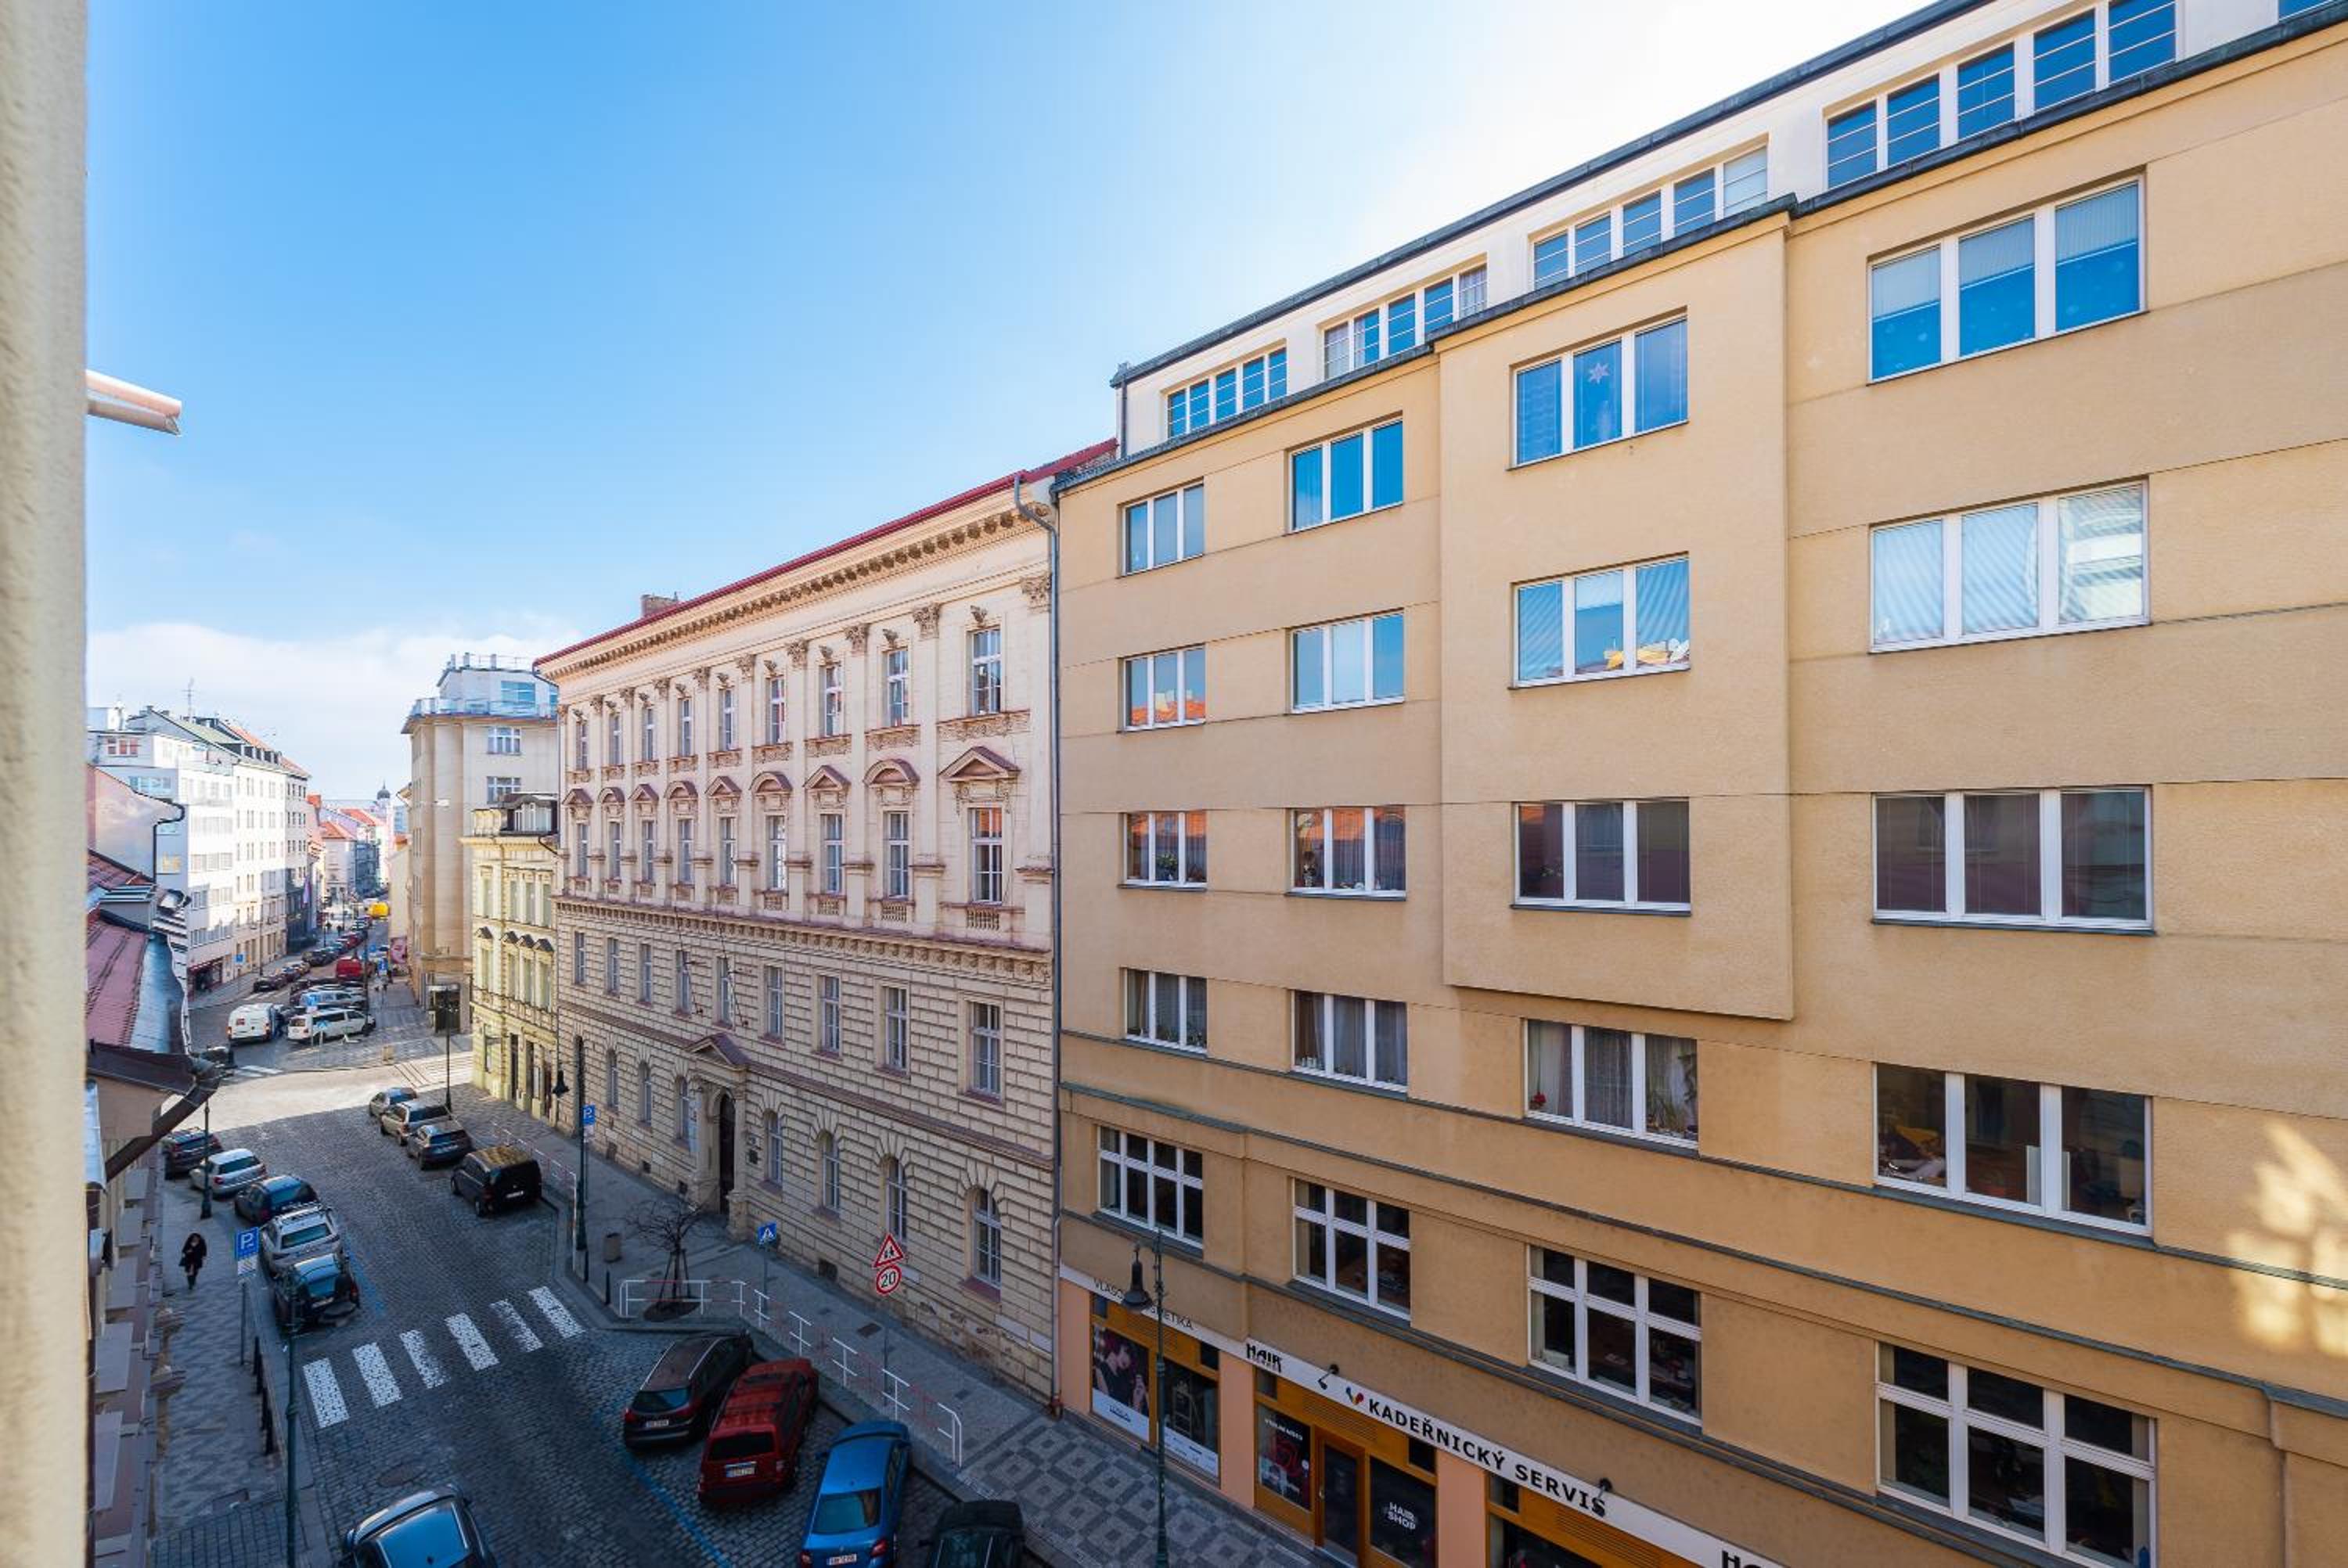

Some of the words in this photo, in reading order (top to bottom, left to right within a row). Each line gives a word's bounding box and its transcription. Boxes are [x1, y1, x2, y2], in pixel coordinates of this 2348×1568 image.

[240, 1232, 254, 1250] P
[880, 1271, 897, 1288] 20
[1246, 1343, 1282, 1373] HAIR
[1369, 1398, 1505, 1471] KADEŘNICKÝ
[1515, 1463, 1607, 1517] SERVIS
[1387, 1511, 1416, 1530] SHOP
[1389, 1501, 1415, 1522] HAIR
